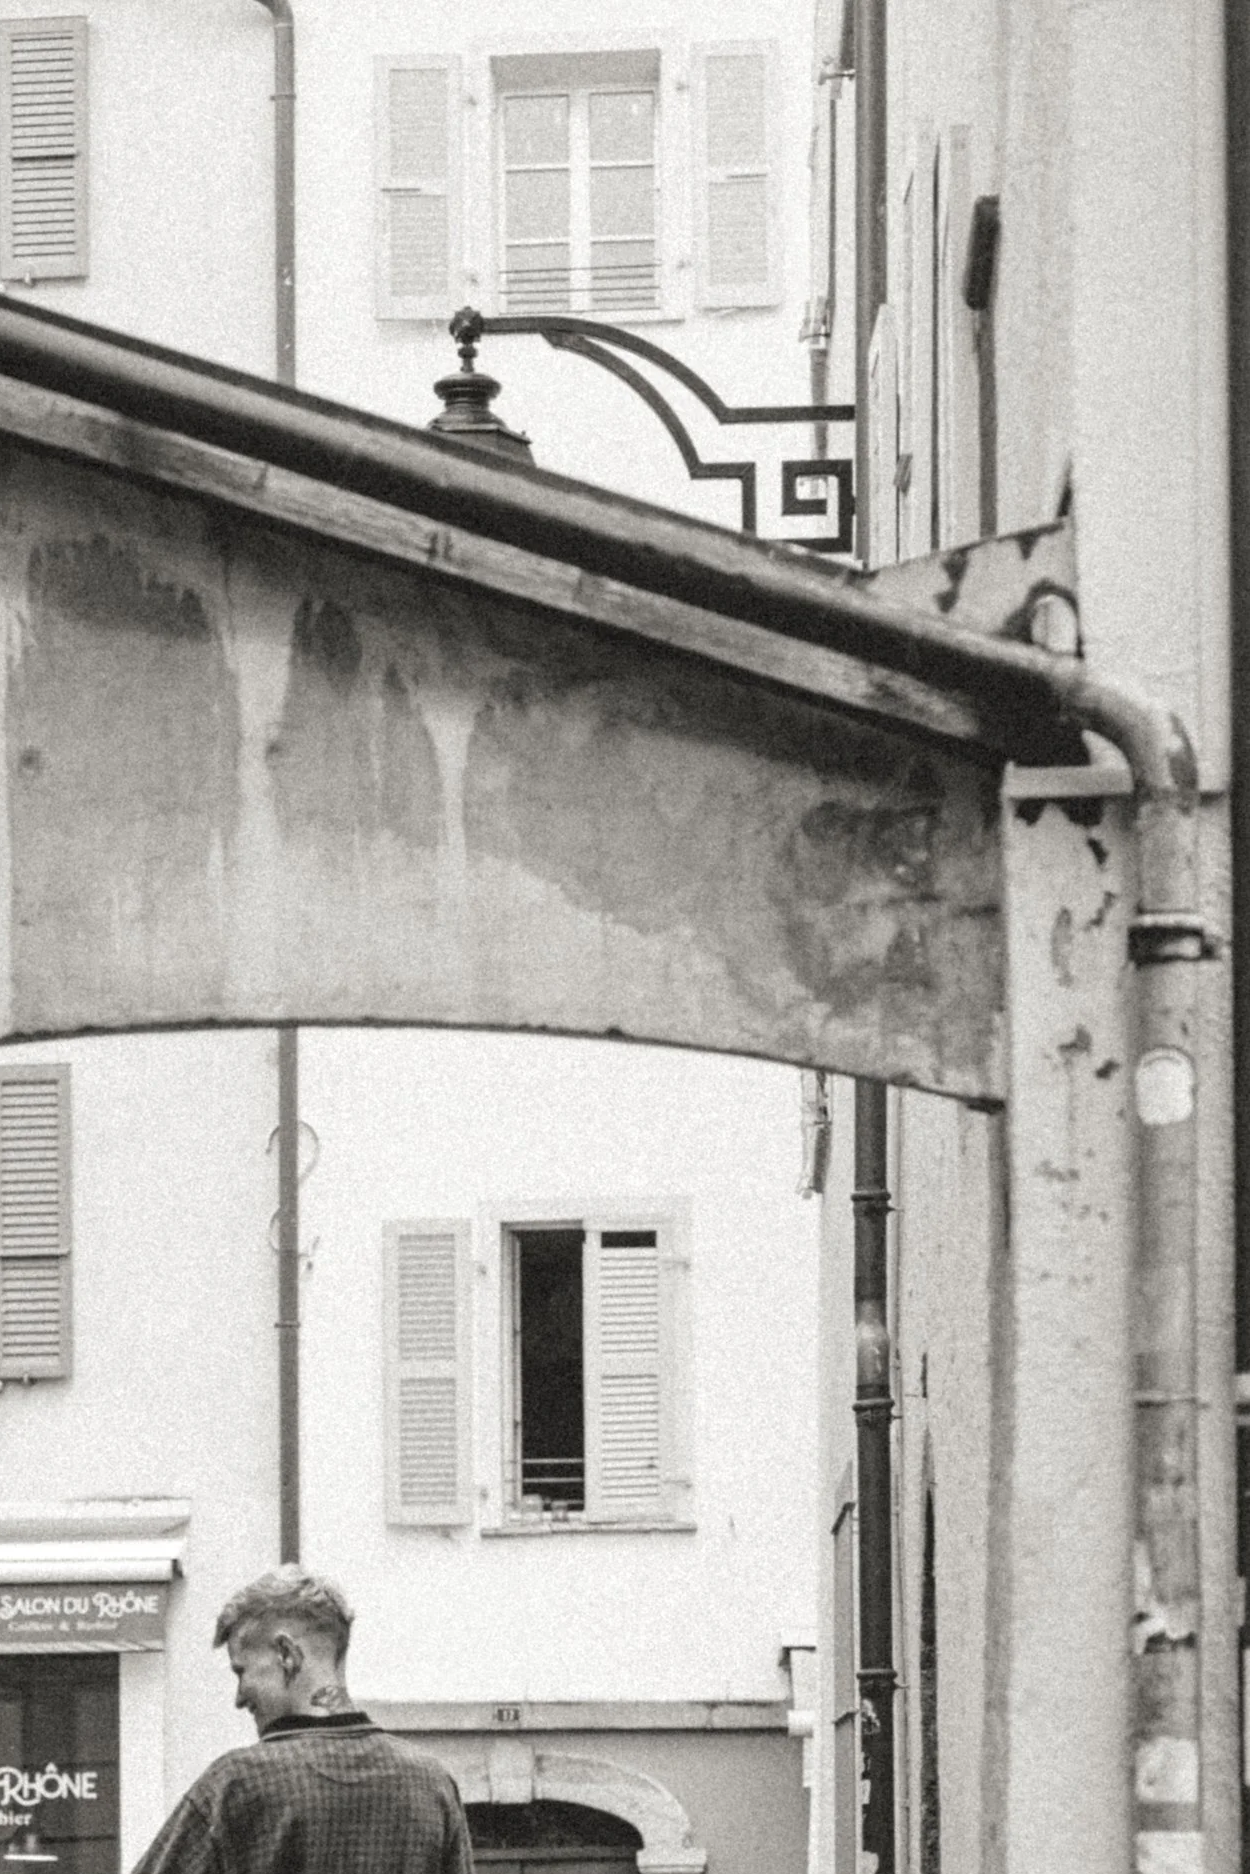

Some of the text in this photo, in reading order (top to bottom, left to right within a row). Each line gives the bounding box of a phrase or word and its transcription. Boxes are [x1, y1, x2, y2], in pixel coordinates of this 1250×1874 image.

[0, 1594, 61, 1620] SALON
[63, 1596, 90, 1615] DU
[92, 1590, 160, 1619] RHÔNE
